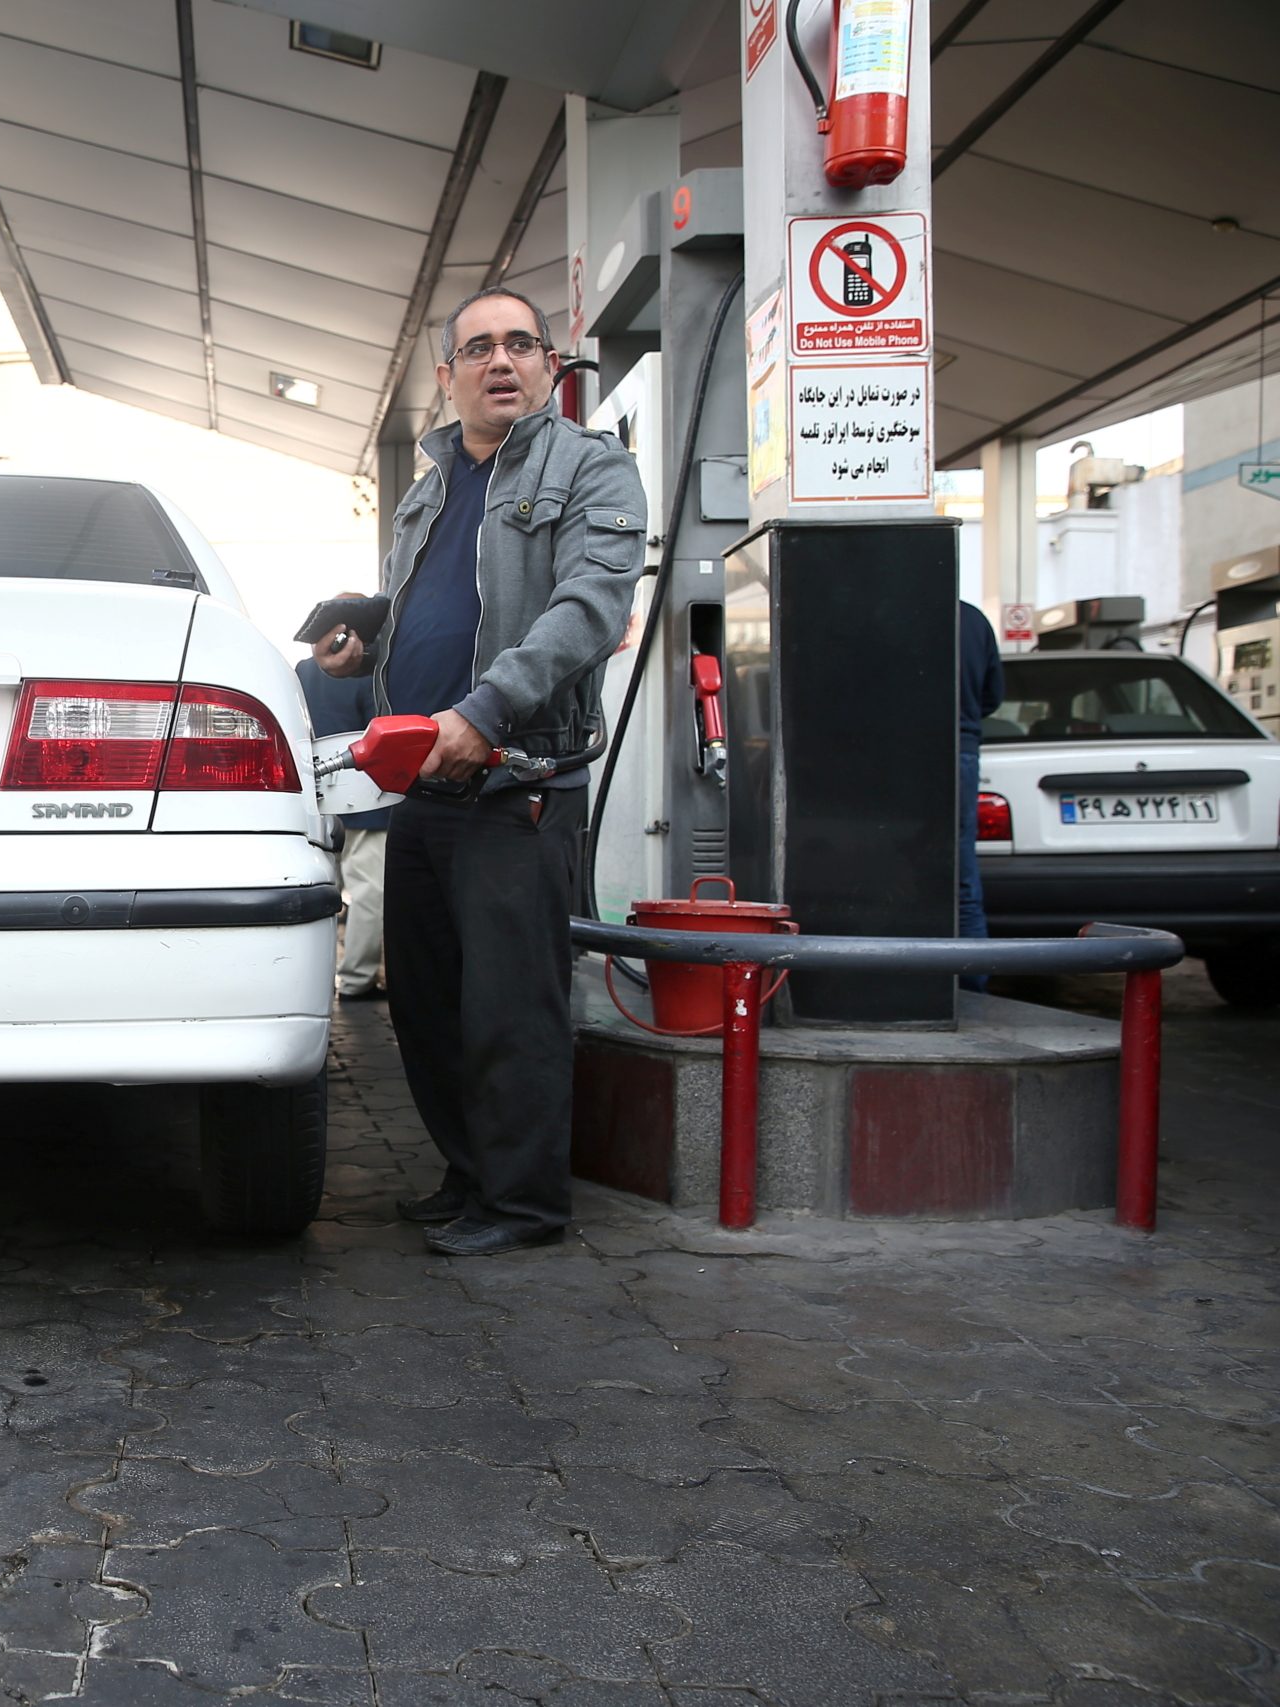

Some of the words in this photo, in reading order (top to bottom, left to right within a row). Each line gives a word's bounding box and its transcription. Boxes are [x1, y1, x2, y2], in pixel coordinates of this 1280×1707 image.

[672, 186, 692, 230] 9
[829, 322, 854, 334] همراه
[855, 321, 874, 334] تلفن
[875, 321, 883, 332] از
[884, 320, 916, 330] استفاده
[800, 338, 814, 349] Do
[815, 337, 833, 348] Not
[834, 337, 853, 348] Use
[855, 335, 887, 347] Mobile
[888, 334, 919, 346] Phone
[799, 386, 826, 408] جایگاه
[828, 385, 842, 408] این
[844, 389, 855, 408] در
[857, 385, 880, 407] تمایل
[882, 388, 908, 407] صورت
[910, 387, 920, 406] در
[800, 422, 820, 444] تلمبه
[822, 421, 849, 444] اپراتور
[851, 421, 875, 443] توسط
[876, 420, 920, 443] سوختگیری
[832, 458, 849, 480] شود
[851, 463, 864, 479] می
[866, 456, 889, 479] انجام
[32, 803, 133, 819] SAMAND
